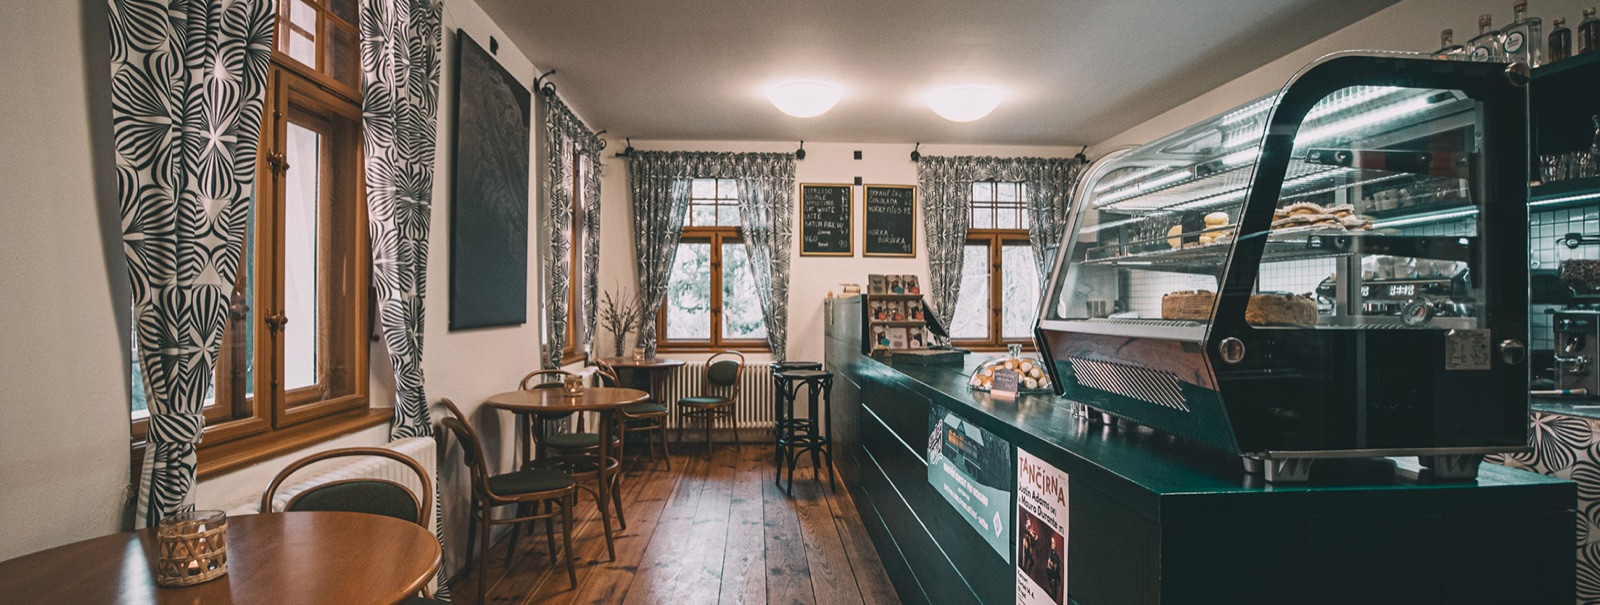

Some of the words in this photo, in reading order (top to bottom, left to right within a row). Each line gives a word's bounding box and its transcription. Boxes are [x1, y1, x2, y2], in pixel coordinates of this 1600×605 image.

[1018, 481, 1032, 499] Justin
[1031, 491, 1050, 511] Adams
[1019, 456, 1066, 507] TANČÍRNA
[1021, 494, 1037, 513] Mauro
[1037, 505, 1059, 530] Durante
